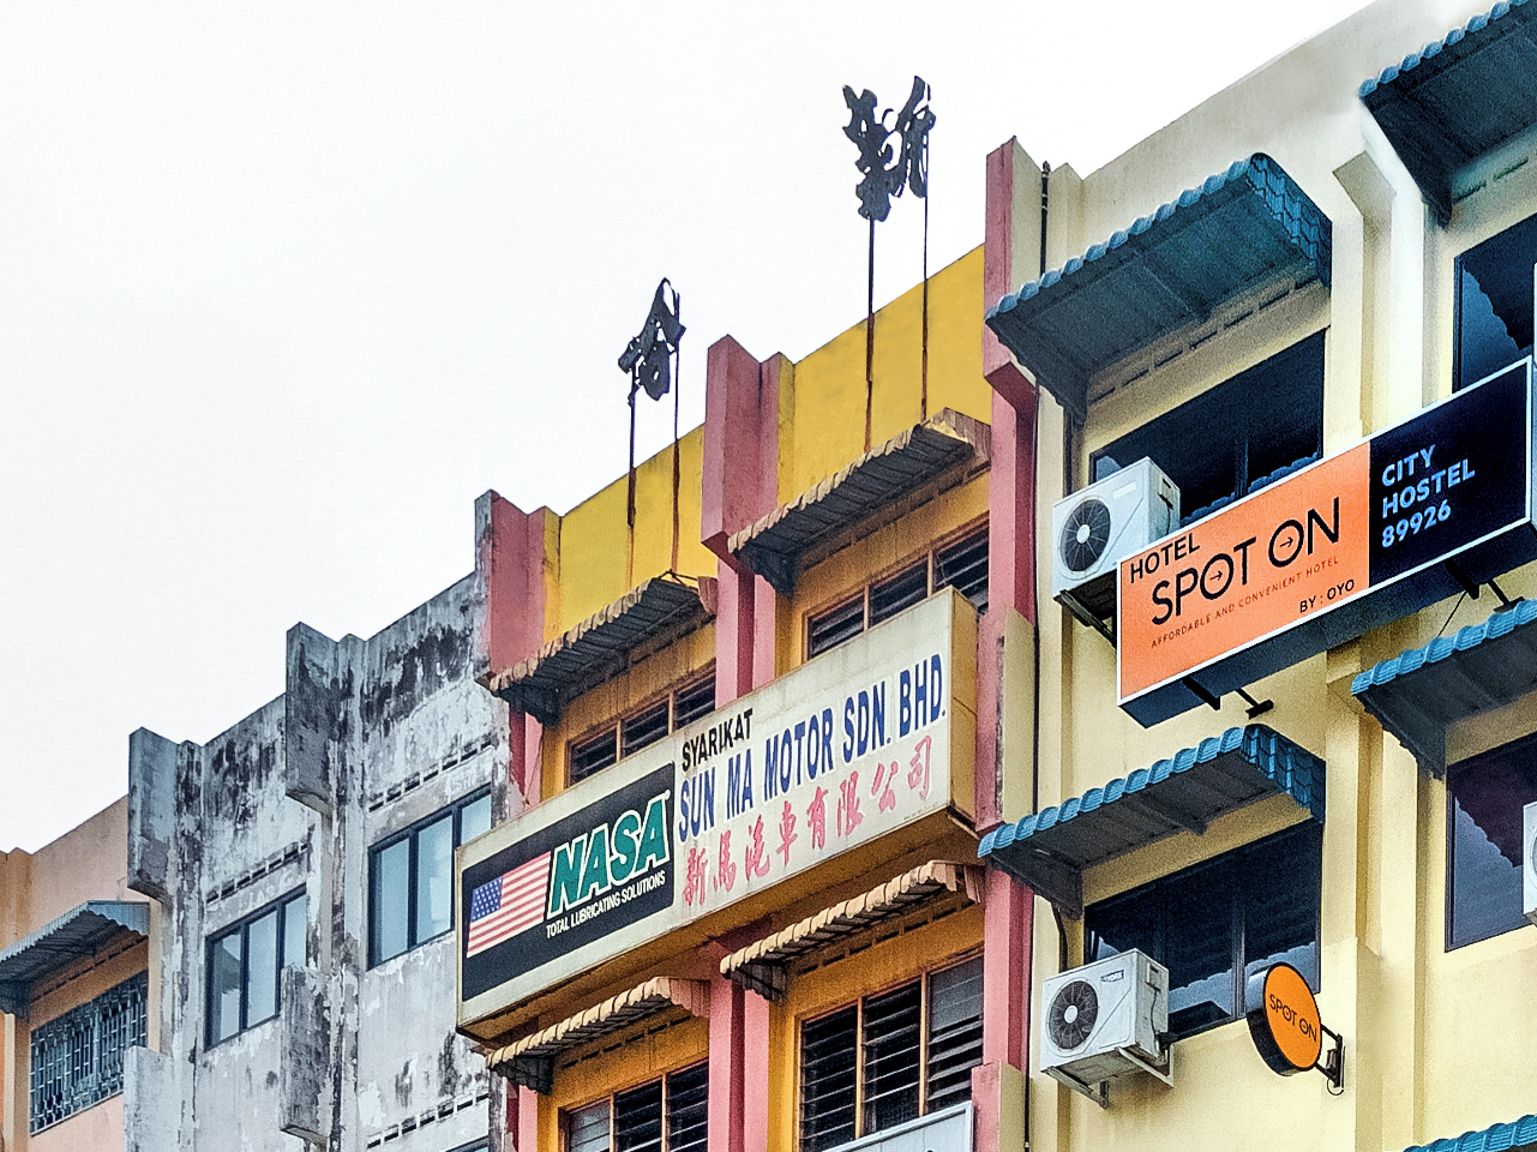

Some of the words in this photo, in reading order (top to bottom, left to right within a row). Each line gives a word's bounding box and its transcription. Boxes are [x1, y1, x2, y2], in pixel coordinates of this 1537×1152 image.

[1382, 443, 1436, 487] CITY
[1382, 458, 1475, 519] HOSTEL
[1381, 501, 1451, 549] 89926
[1130, 534, 1200, 583] HOTEL
[1151, 537, 1256, 625] SPOT
[1268, 497, 1340, 567] ON
[1151, 613, 1211, 648] AFFORDABLE
[1214, 603, 1235, 620] AND
[1238, 572, 1301, 608] CONVENIENT
[1305, 555, 1338, 578] HOTEL
[1299, 596, 1316, 613] BY
[1326, 579, 1355, 601] OYO
[678, 765, 717, 842] SUN
[726, 752, 754, 819] MA
[763, 707, 833, 802] MOTOR
[842, 681, 891, 763] SDN.
[899, 653, 947, 738] BHD.
[682, 708, 753, 772] SYARIKAT
[547, 791, 671, 920] NASA
[546, 918, 570, 939] TOTAL
[570, 894, 621, 933] LUBRICATING
[621, 870, 667, 910] SOLUTIONS
[1269, 993, 1297, 1026] SPOT
[1299, 1017, 1317, 1043] ON
